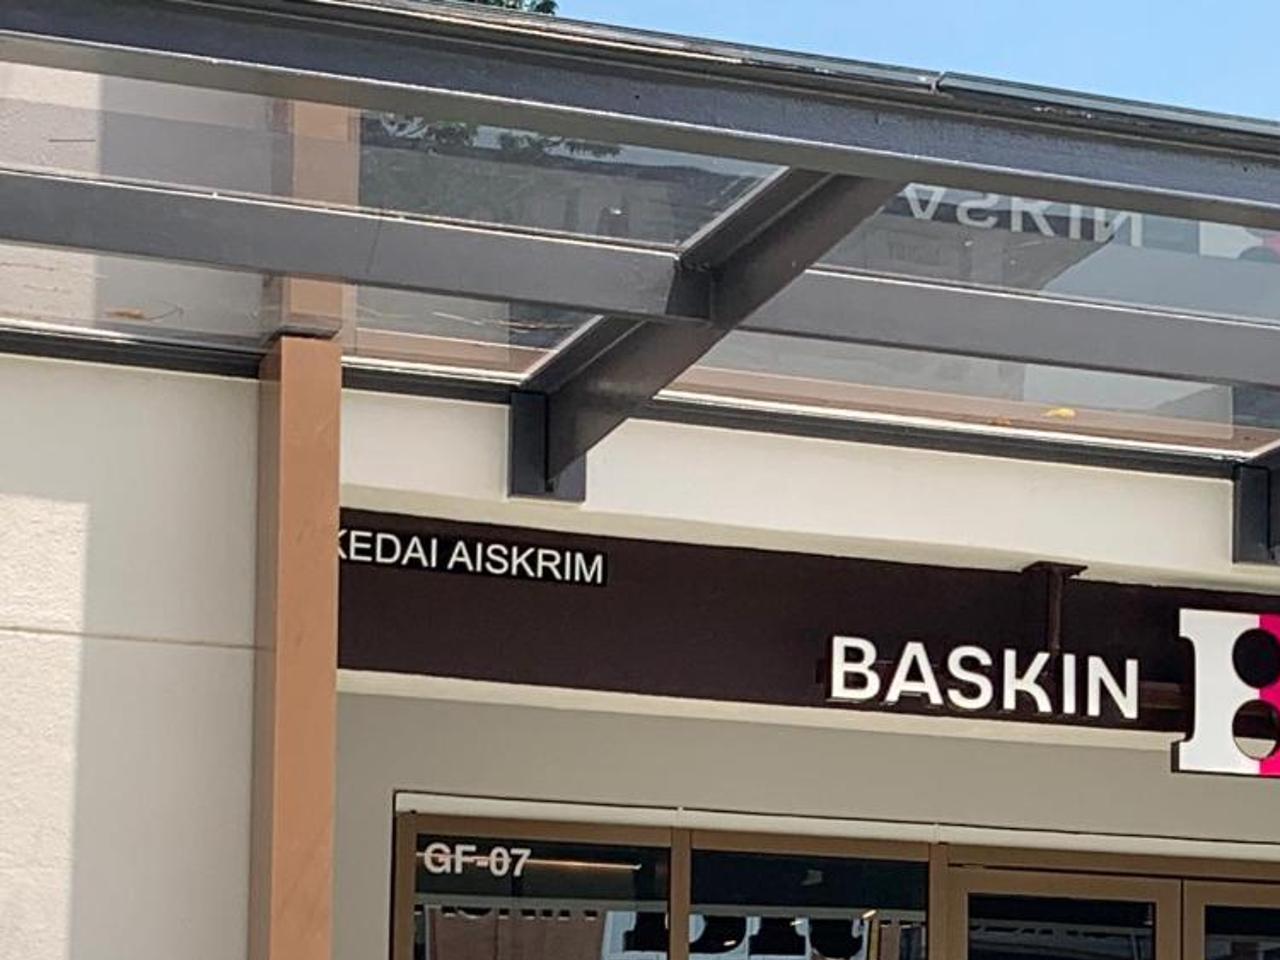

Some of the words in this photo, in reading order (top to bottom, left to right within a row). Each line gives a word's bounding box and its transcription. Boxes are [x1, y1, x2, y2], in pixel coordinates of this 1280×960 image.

[447, 541, 604, 585] AISKRIM
[830, 636, 1138, 719] BASKIN
[424, 842, 532, 877] GF-07
